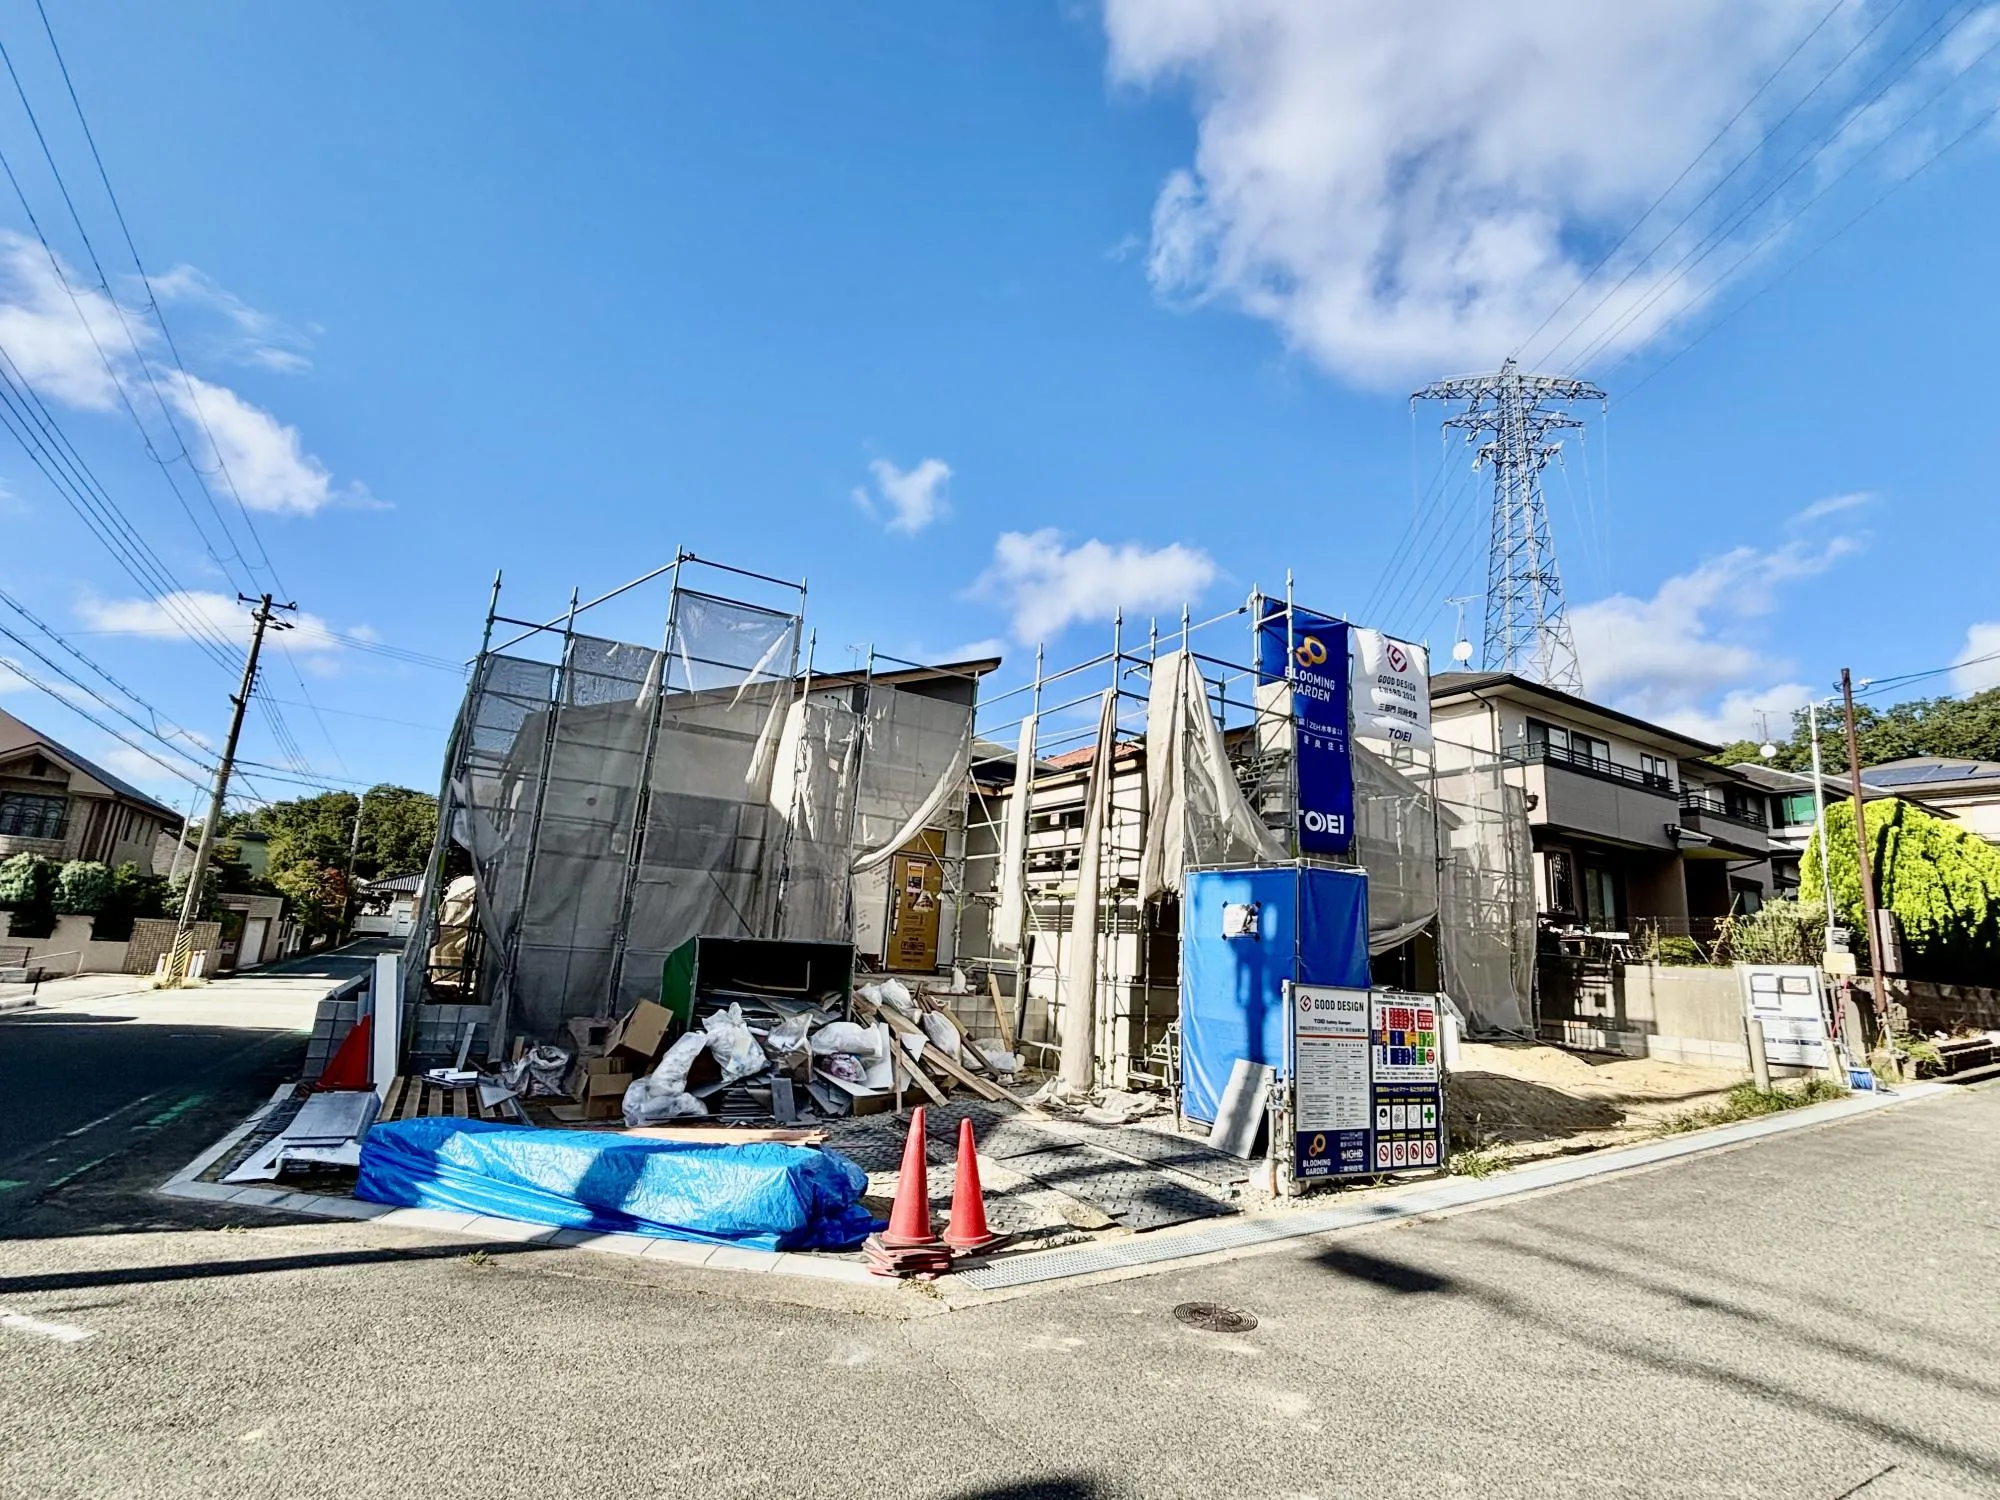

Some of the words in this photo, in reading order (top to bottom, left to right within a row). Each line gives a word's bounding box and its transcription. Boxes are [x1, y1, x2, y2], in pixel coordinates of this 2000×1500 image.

[1285, 666, 1335, 690] BLOOMING
[1378, 675, 1395, 685] GOOD
[1396, 678, 1416, 692] DESIGN
[1388, 727, 1412, 743] TOEI
[1314, 999, 1335, 1010] GOOD
[1337, 1000, 1364, 1012] DESIGN
[1302, 1159, 1331, 1168] BLOOMING
[1305, 1167, 1328, 1175] GARDEN
